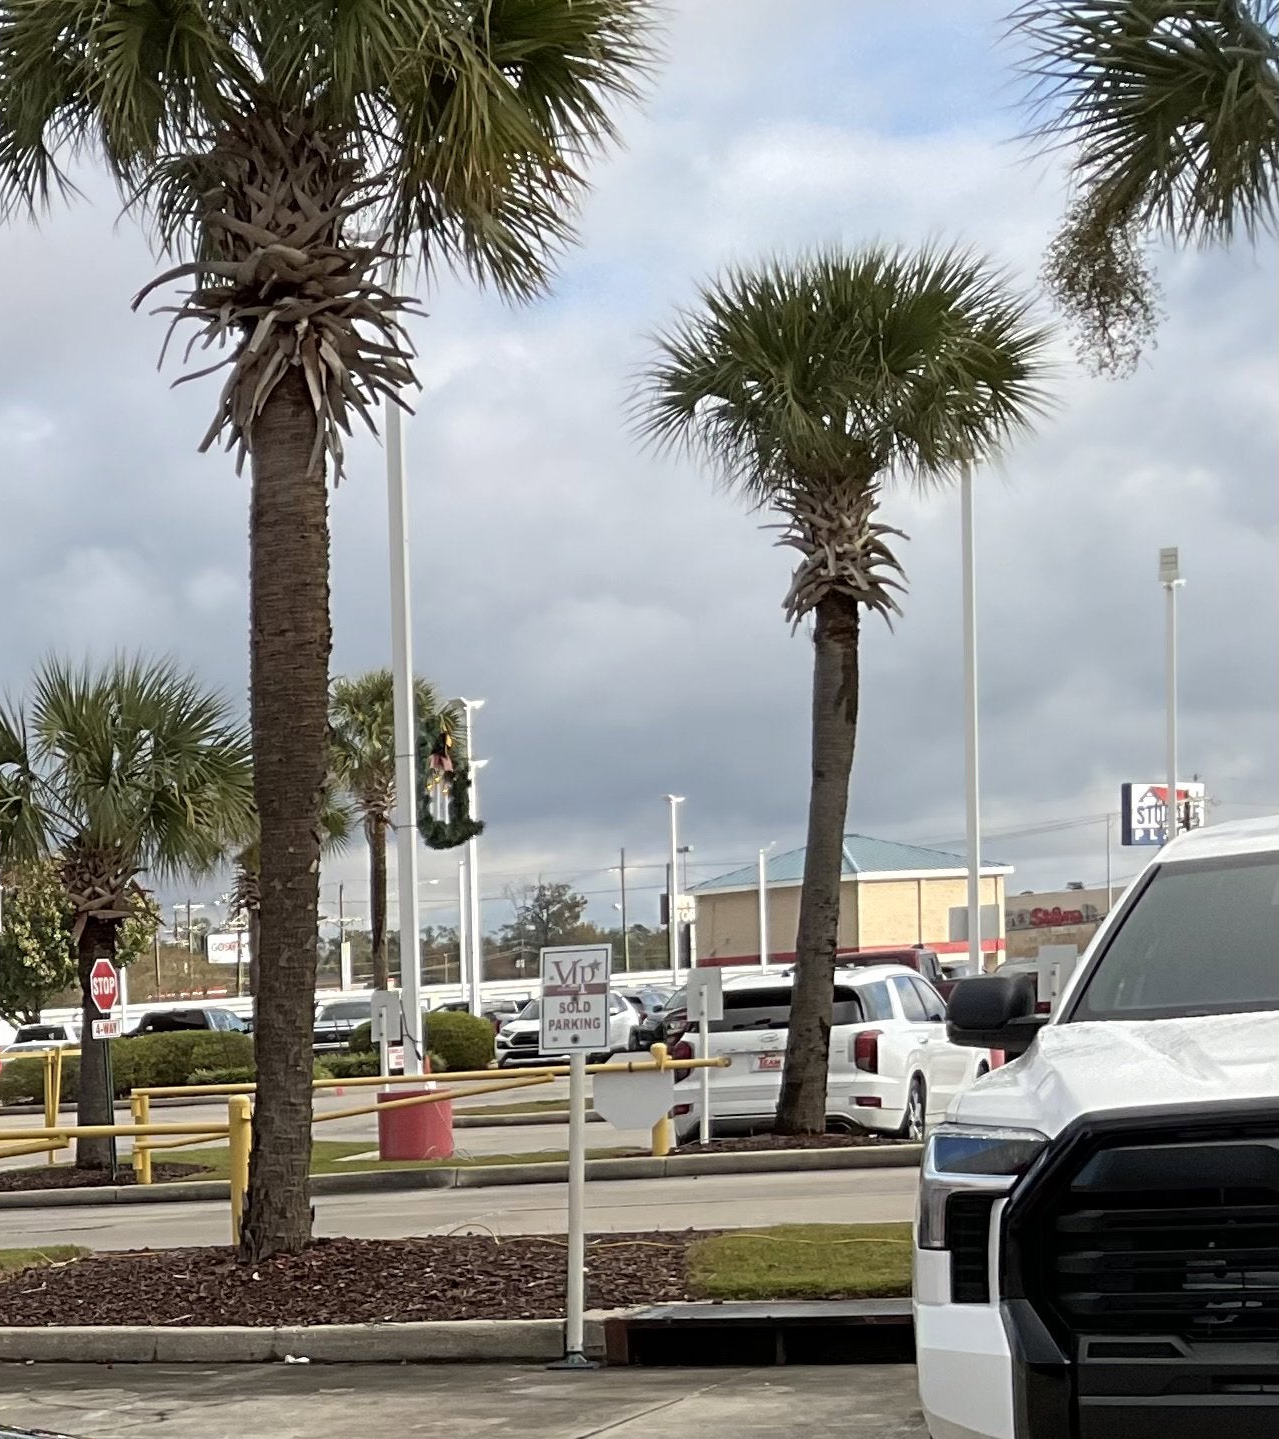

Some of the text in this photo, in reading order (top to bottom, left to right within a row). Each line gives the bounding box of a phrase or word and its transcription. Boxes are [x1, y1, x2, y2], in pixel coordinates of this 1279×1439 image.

[93, 977, 115, 996] STOP
[559, 1001, 591, 1014] SOLD
[95, 1022, 118, 1035] 4-WAY
[548, 1017, 601, 1031] PARKING
